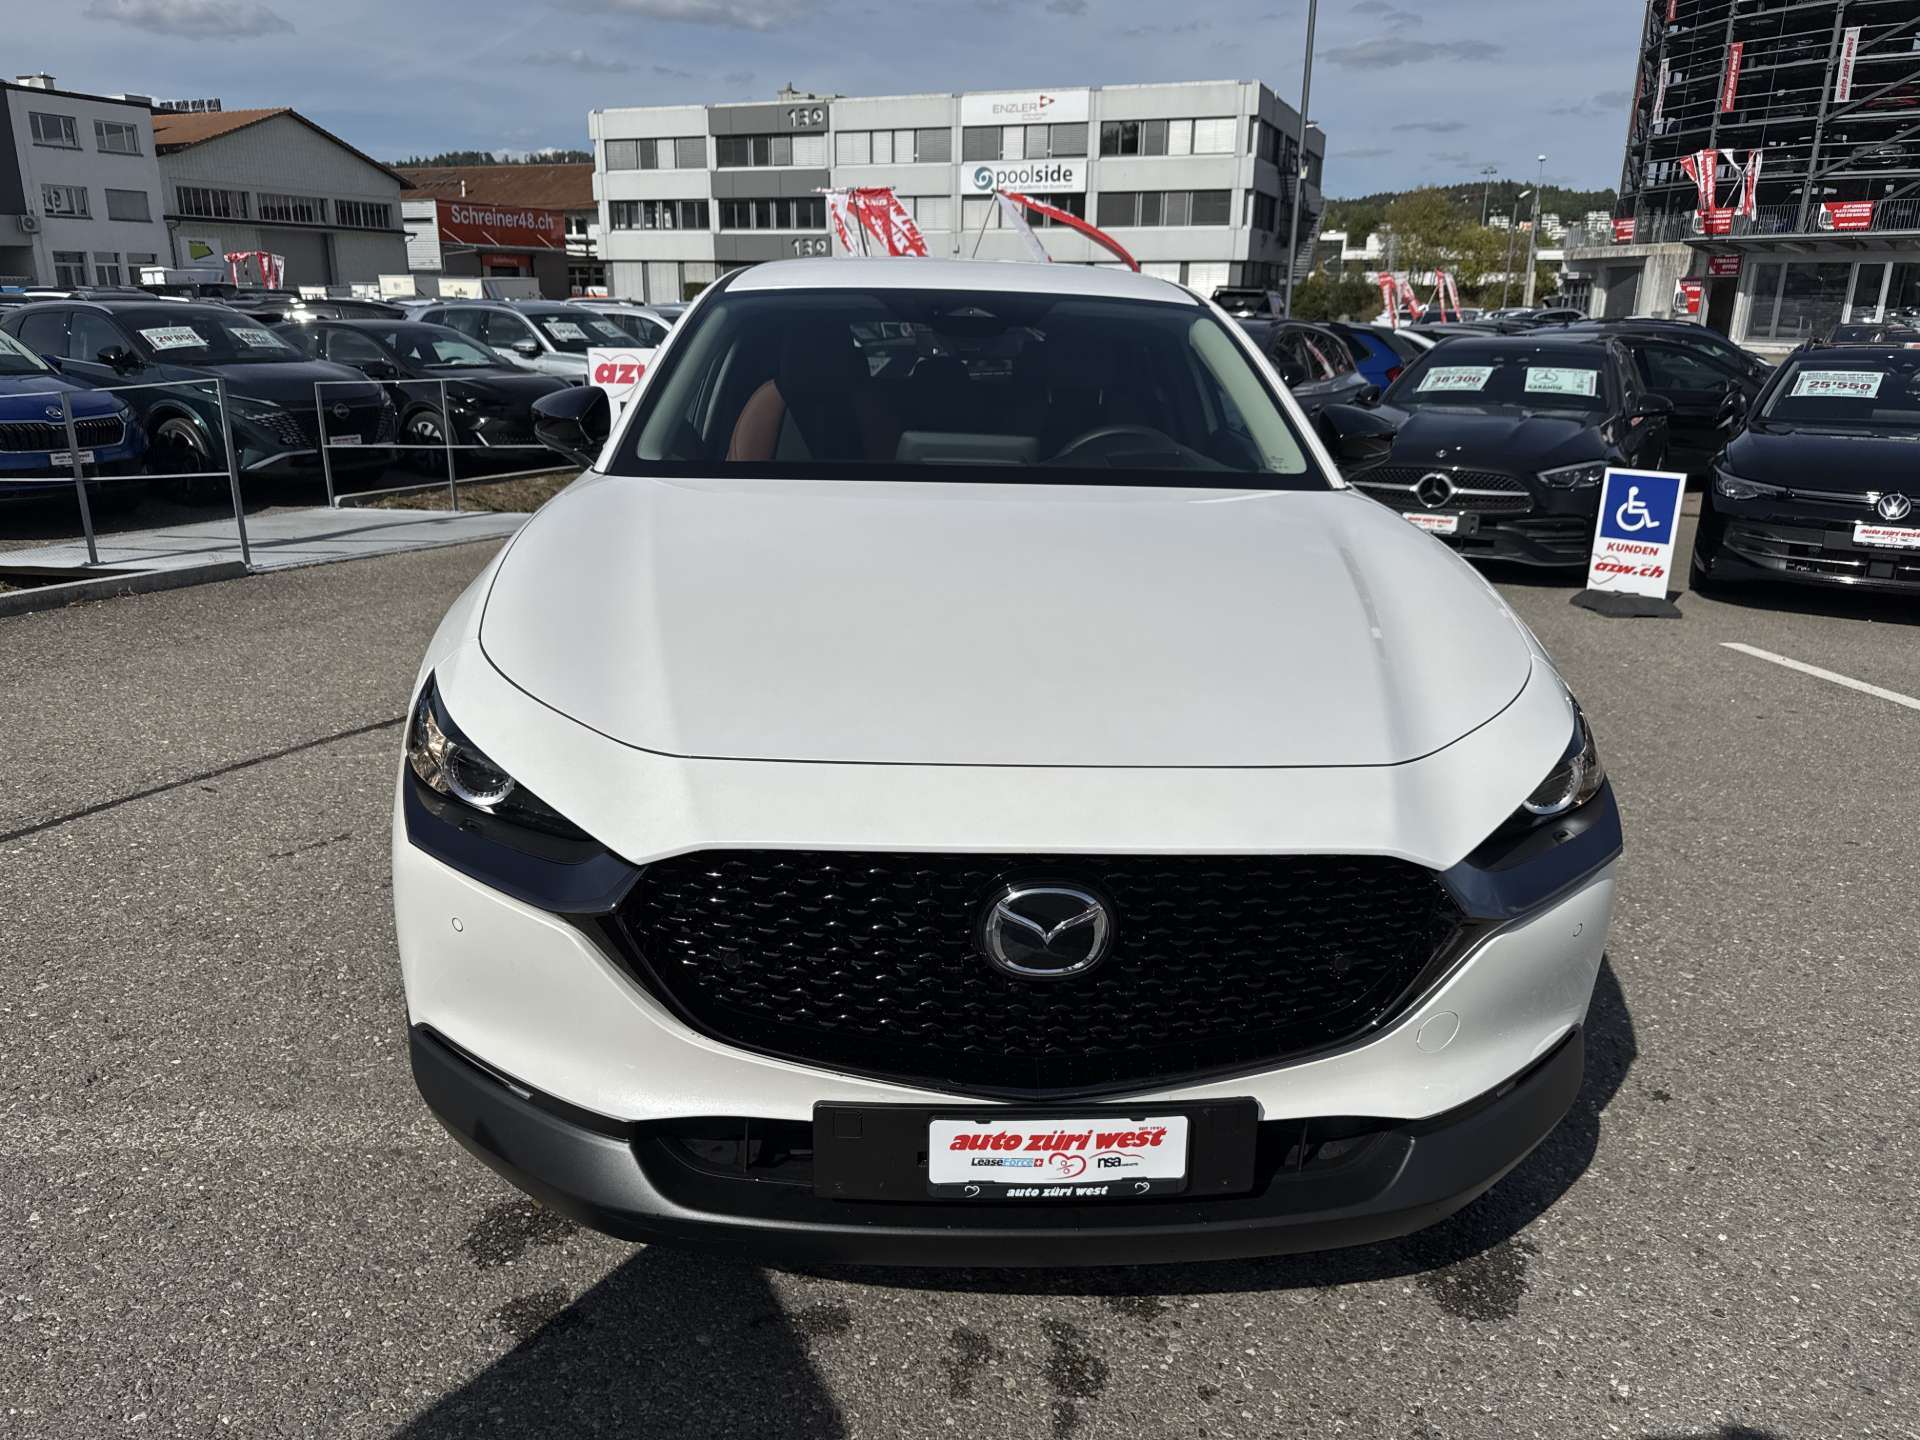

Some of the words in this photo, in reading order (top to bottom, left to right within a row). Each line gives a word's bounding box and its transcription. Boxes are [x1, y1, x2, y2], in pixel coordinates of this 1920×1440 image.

[992, 102, 1038, 114] ENZLER
[788, 108, 824, 127] 139
[996, 164, 1073, 187] poolside
[451, 204, 554, 230] Schreiner48.ch
[792, 238, 827, 257] 139
[1807, 380, 1872, 390] 25'550
[1606, 542, 1660, 556] KUNDEN
[1594, 562, 1665, 578] azw.ch
[949, 1131, 1023, 1151] auto
[1023, 1129, 1093, 1151] züri
[1095, 1127, 1167, 1149] west
[971, 1157, 1034, 1168] LeaseForce
[1097, 1156, 1122, 1169] nsa
[1006, 1187, 1040, 1197] auto
[1041, 1186, 1074, 1197] züri
[1075, 1185, 1109, 1196] west
